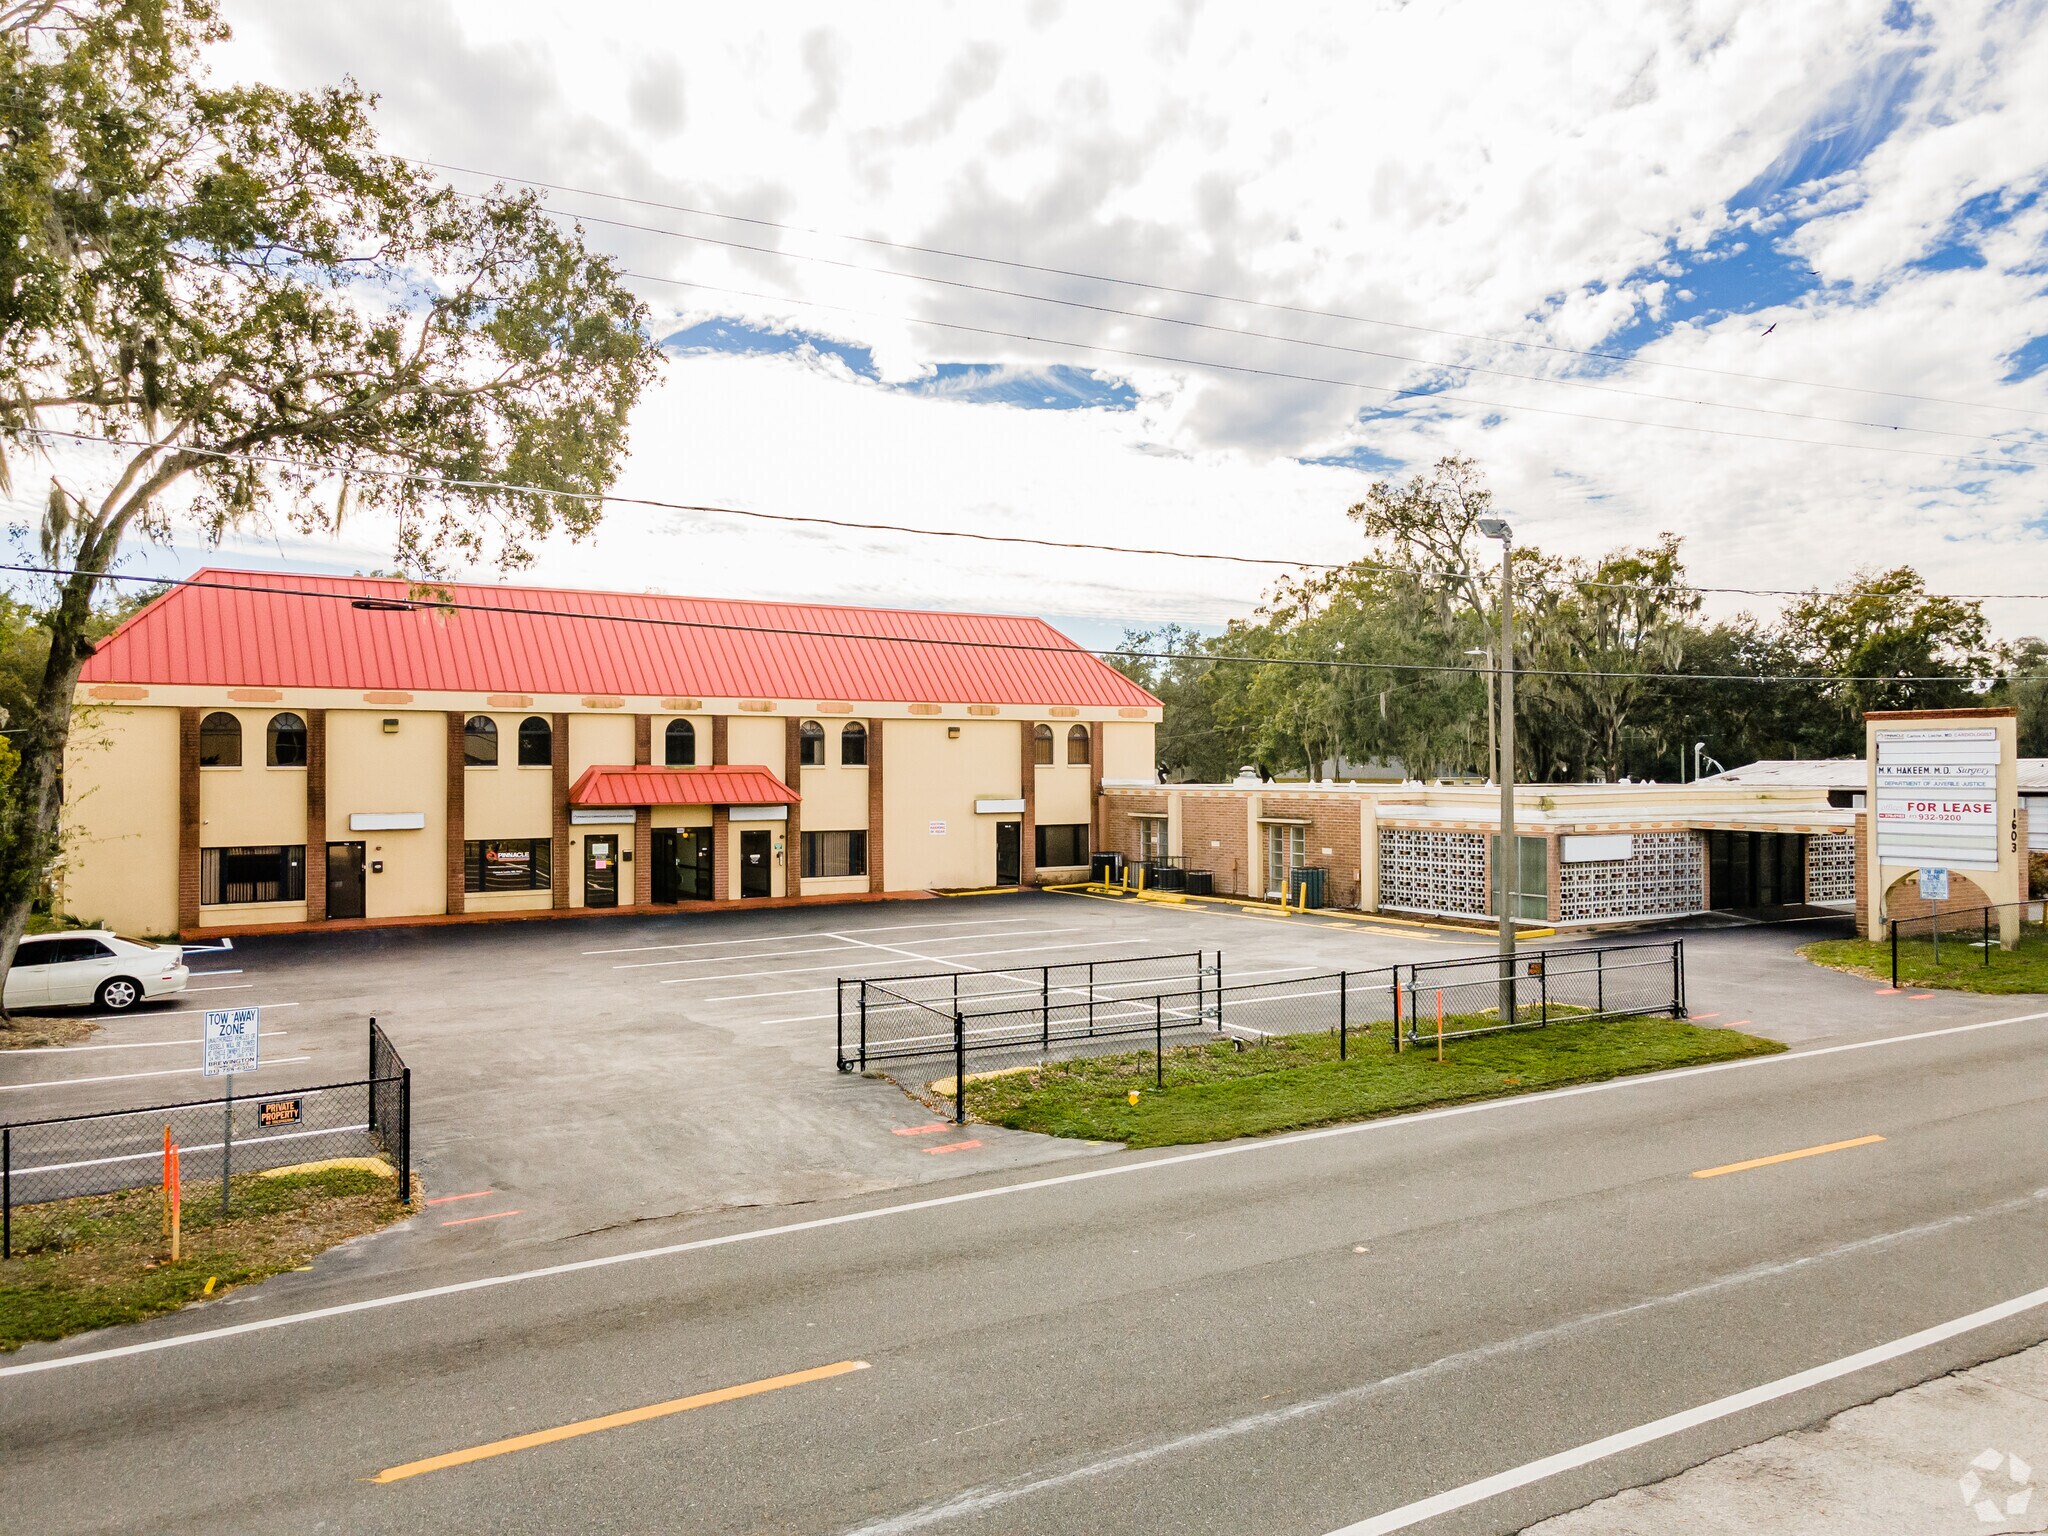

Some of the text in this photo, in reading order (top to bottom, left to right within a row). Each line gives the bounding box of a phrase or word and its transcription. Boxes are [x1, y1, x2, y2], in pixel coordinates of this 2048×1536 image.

[1956, 766, 1990, 776] Surgery
[1907, 802, 1937, 812] FOR
[1943, 803, 1992, 814] LEASE
[208, 1010, 256, 1025] TOW AWAY
[219, 1023, 245, 1036] ZONE
[208, 1057, 255, 1067] BREWINGTON
[265, 1101, 295, 1113] PRIVATE
[261, 1109, 299, 1122] PROPERTY
